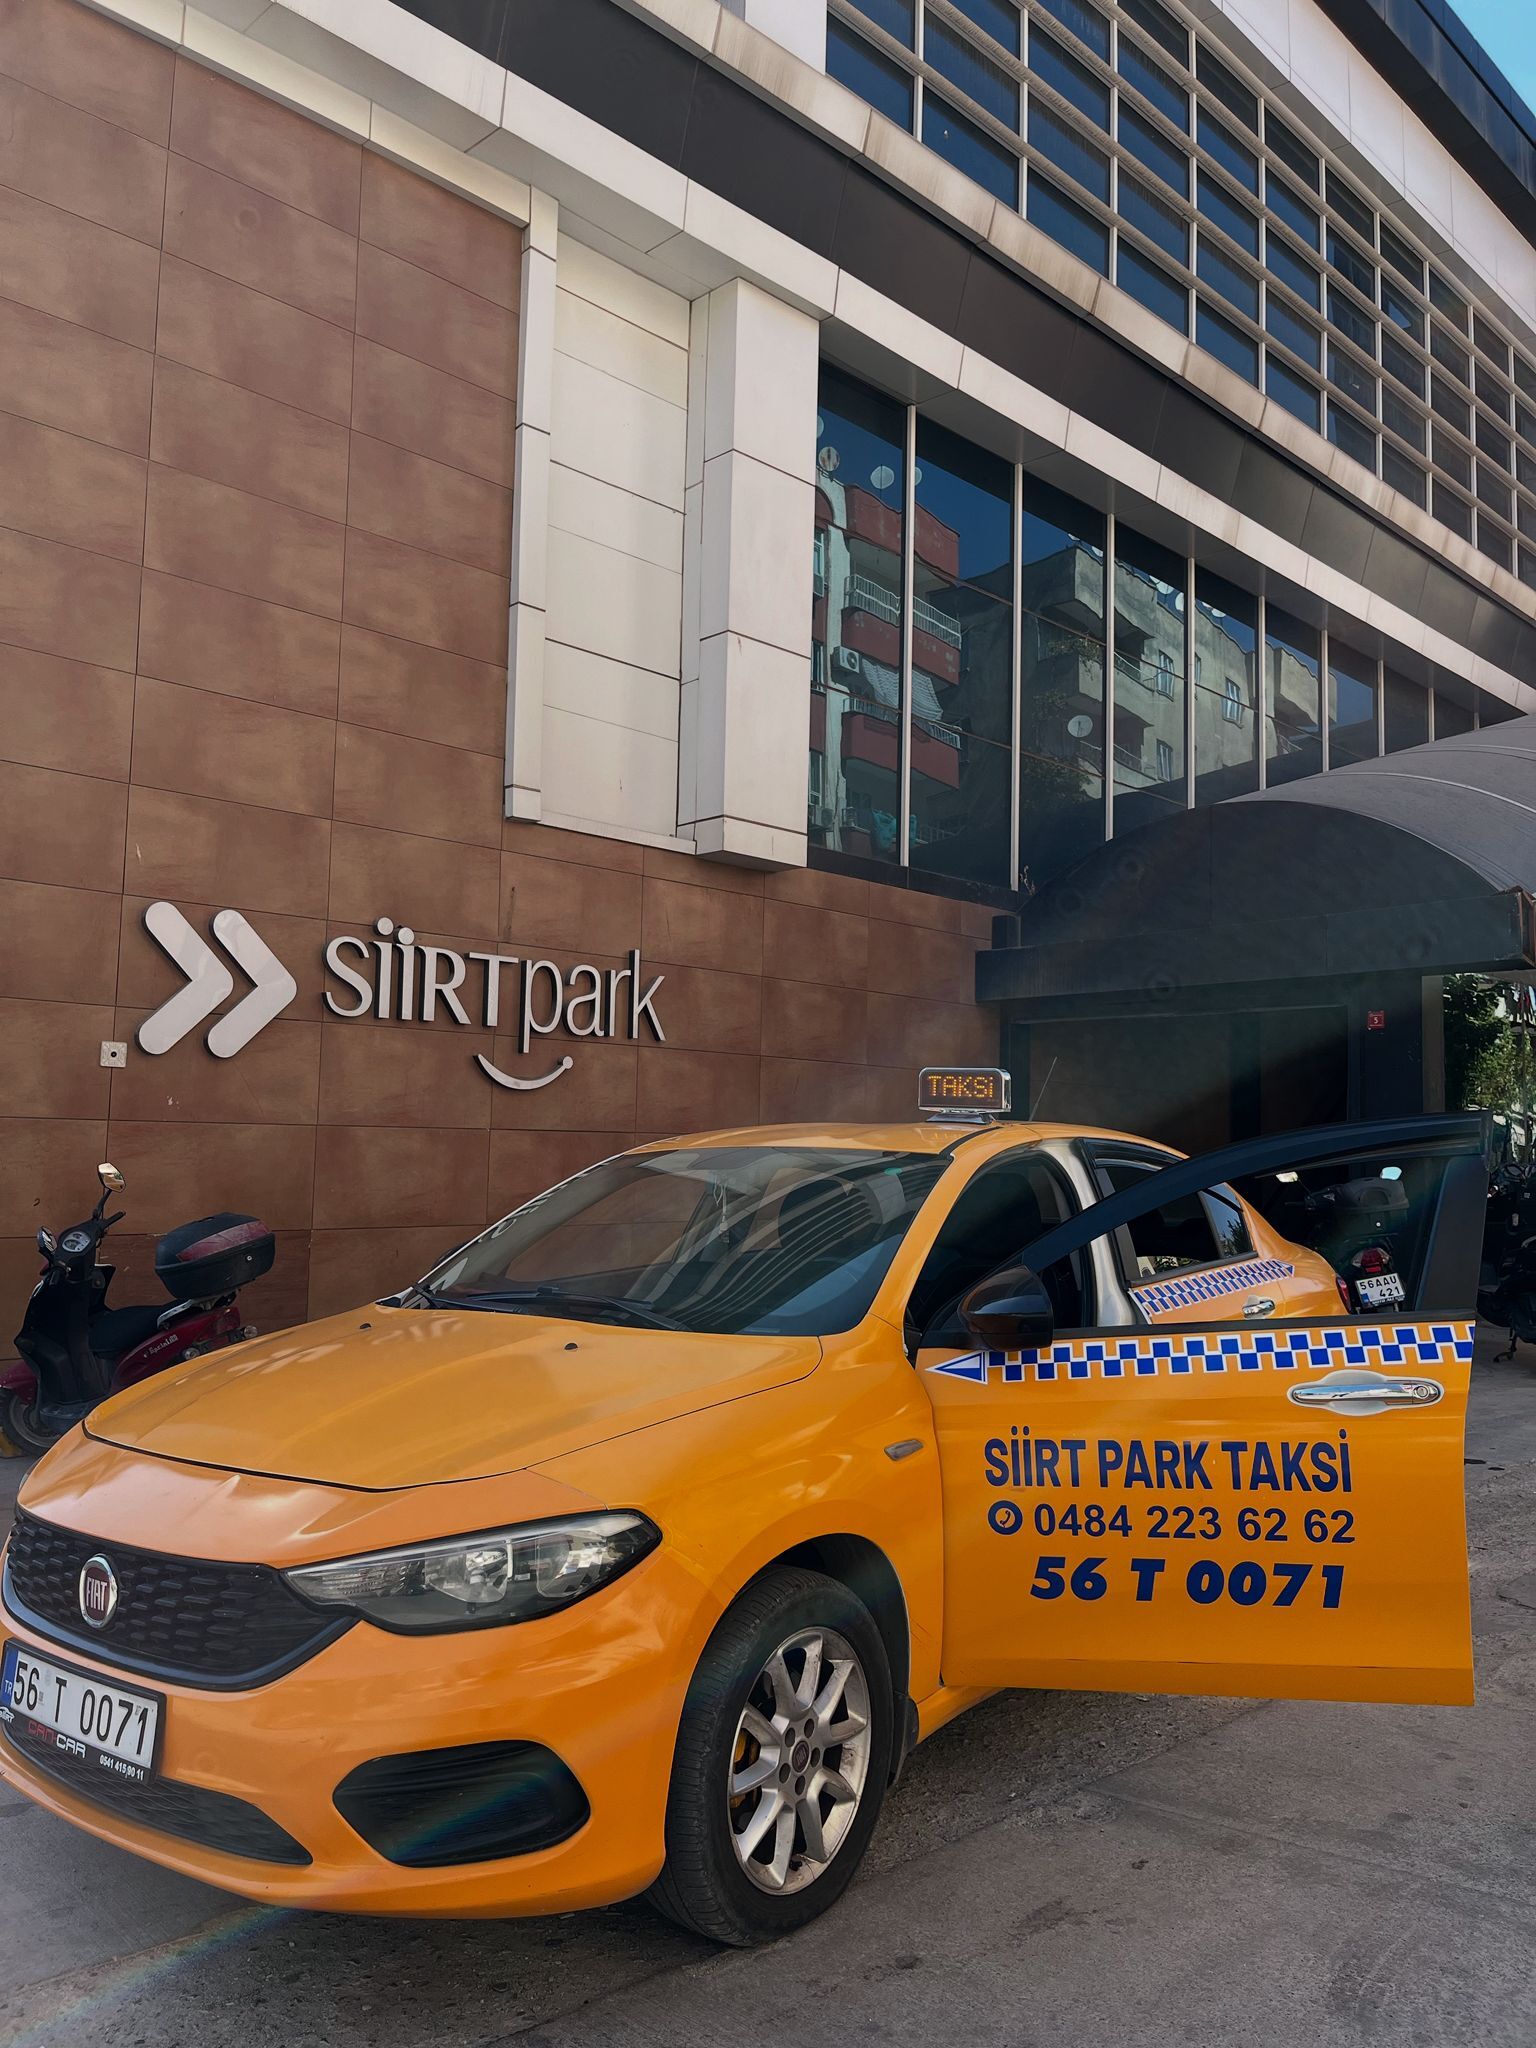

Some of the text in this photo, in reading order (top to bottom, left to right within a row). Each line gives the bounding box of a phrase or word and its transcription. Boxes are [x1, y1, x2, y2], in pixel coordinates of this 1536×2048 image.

[1380, 1286, 1401, 1297] 421
[1097, 1439, 1214, 1490] PARK
[1221, 1428, 1352, 1493] TAKSİ
[1033, 1503, 1355, 1544] 0484 223 62 62
[86, 1576, 107, 1611] FIAT
[1029, 1555, 1345, 1609] 56 T 0071
[4, 1680, 13, 1695] TR
[13, 1660, 148, 1755] 56 T 0071
[100, 1754, 114, 1769] 0541
[114, 1760, 127, 1774] 415
[136, 1768, 144, 1781] 11
